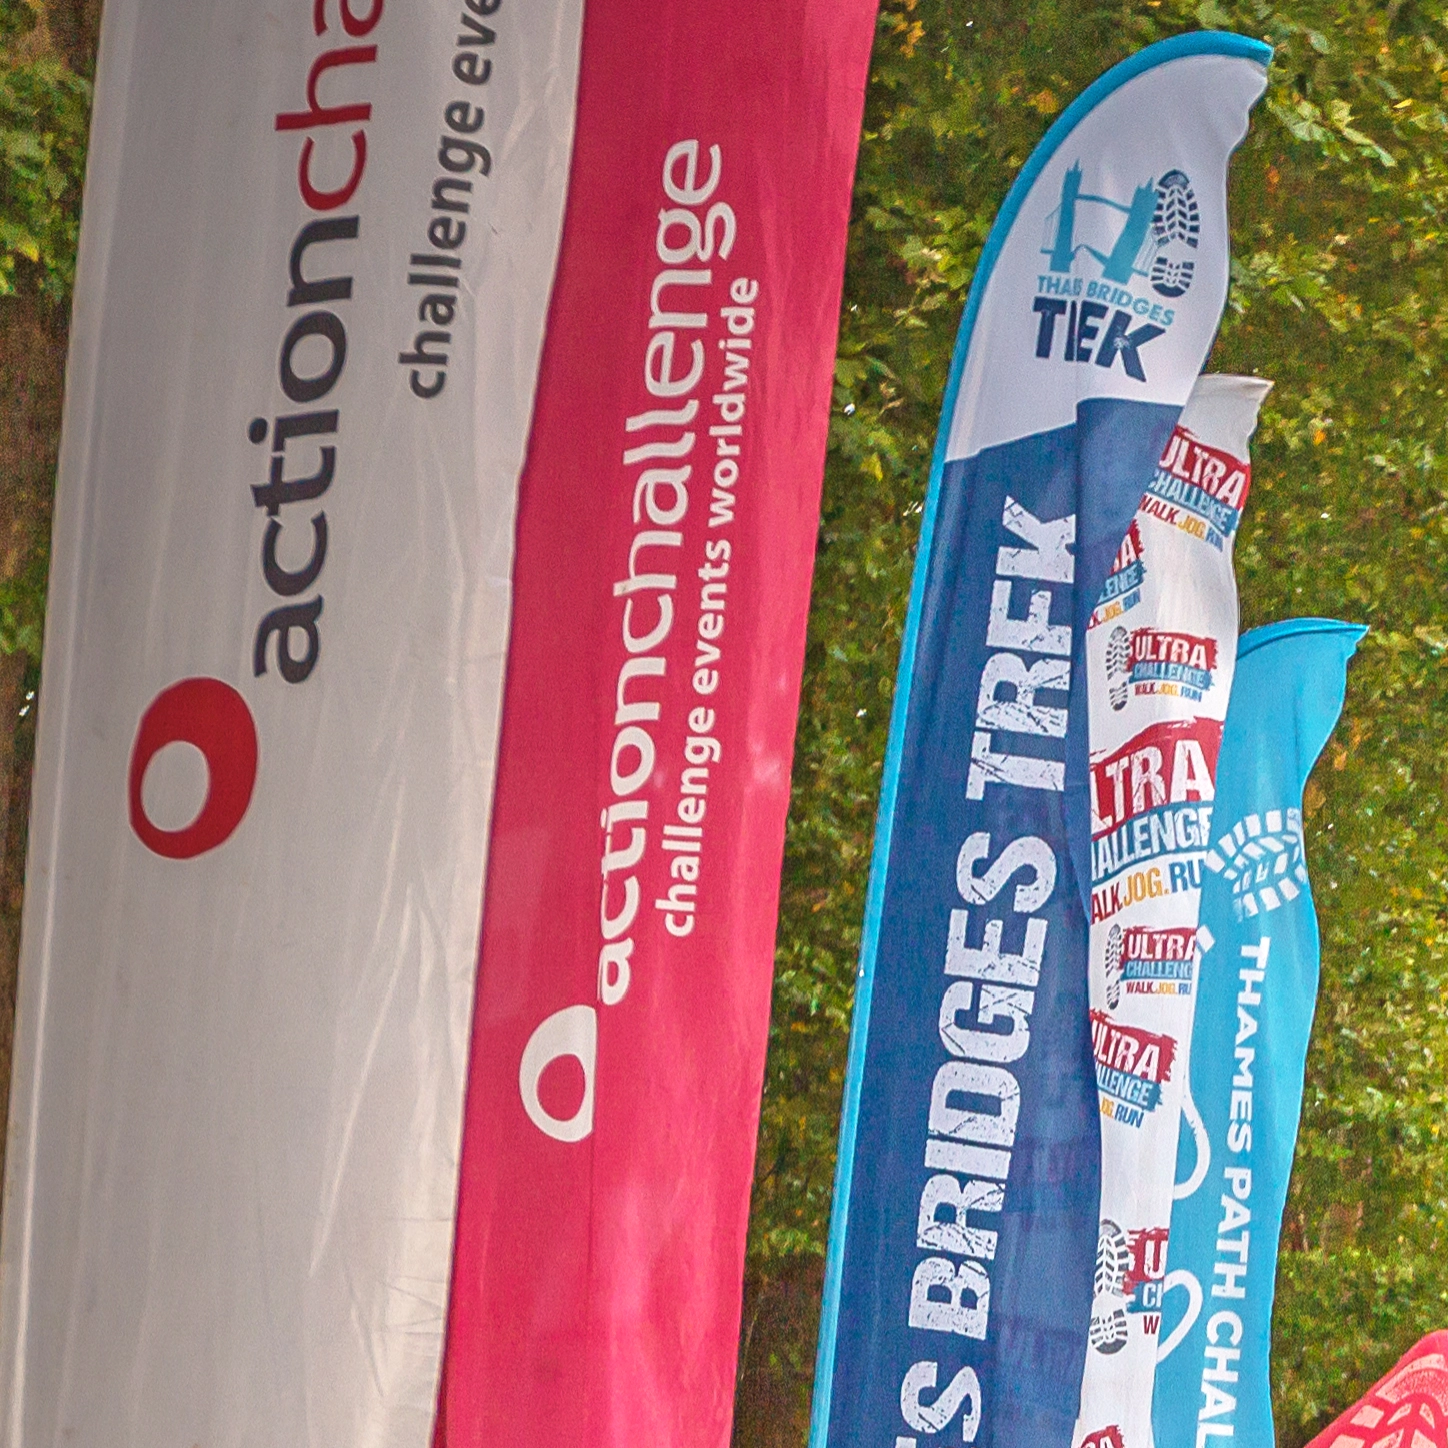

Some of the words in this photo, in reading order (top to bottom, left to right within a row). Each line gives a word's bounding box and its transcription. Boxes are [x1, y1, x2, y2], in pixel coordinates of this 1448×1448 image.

[399, 100, 491, 400] challenge
[1086, 279, 1176, 327] BRIDGES
[706, 276, 761, 528] worldwide
[600, 138, 737, 1005] actionchallenge
[692, 540, 733, 696] events
[965, 495, 1077, 801] TREK
[1134, 635, 1209, 669] ULTRA
[655, 704, 722, 937] challenge
[1090, 739, 1215, 833] LTRA
[908, 830, 1057, 1342] BRIDGES
[1226, 935, 1271, 1156] THAMES
[1210, 1167, 1252, 1301] PATH
